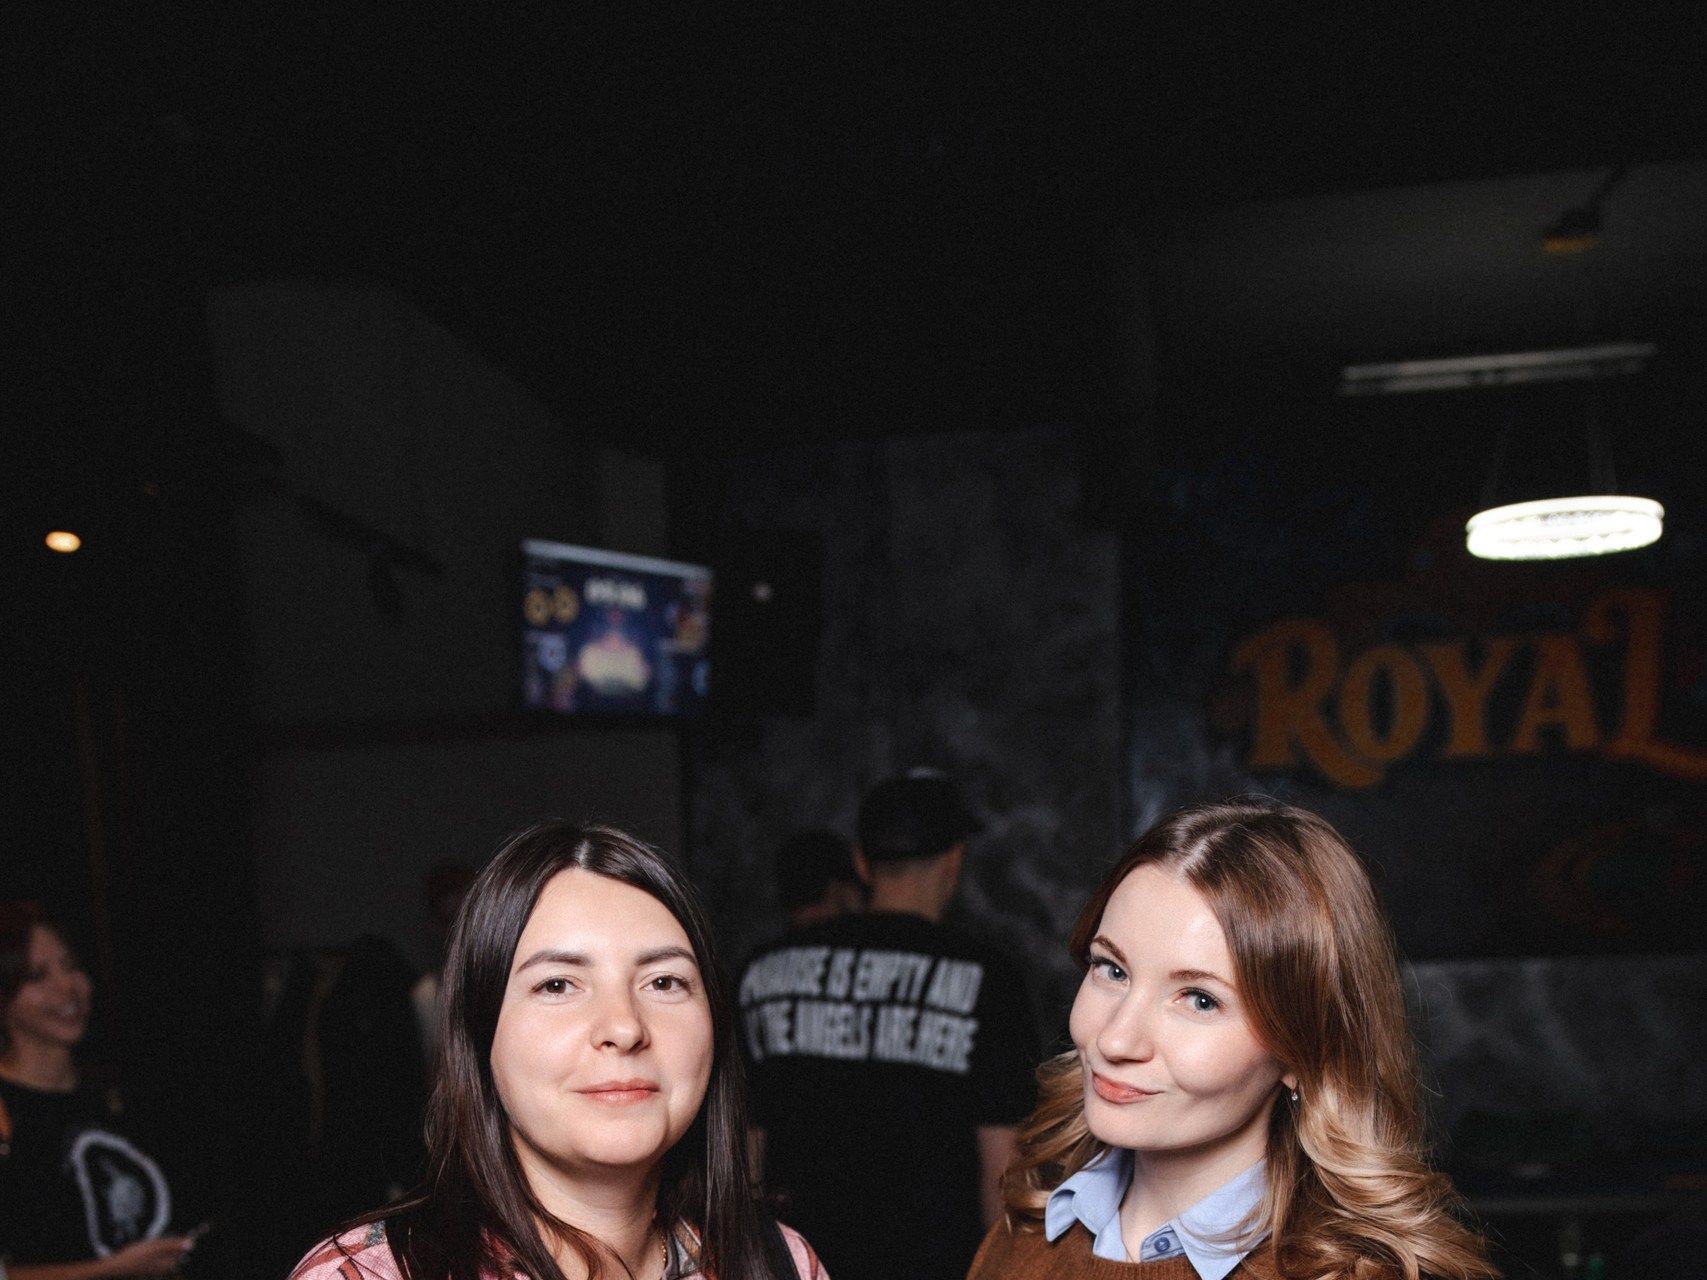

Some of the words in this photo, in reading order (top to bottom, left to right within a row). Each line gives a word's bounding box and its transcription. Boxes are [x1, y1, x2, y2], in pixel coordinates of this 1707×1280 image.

[1233, 587, 1707, 789] ROYAL
[827, 949, 855, 998] IS
[853, 950, 932, 1002] EMPTY
